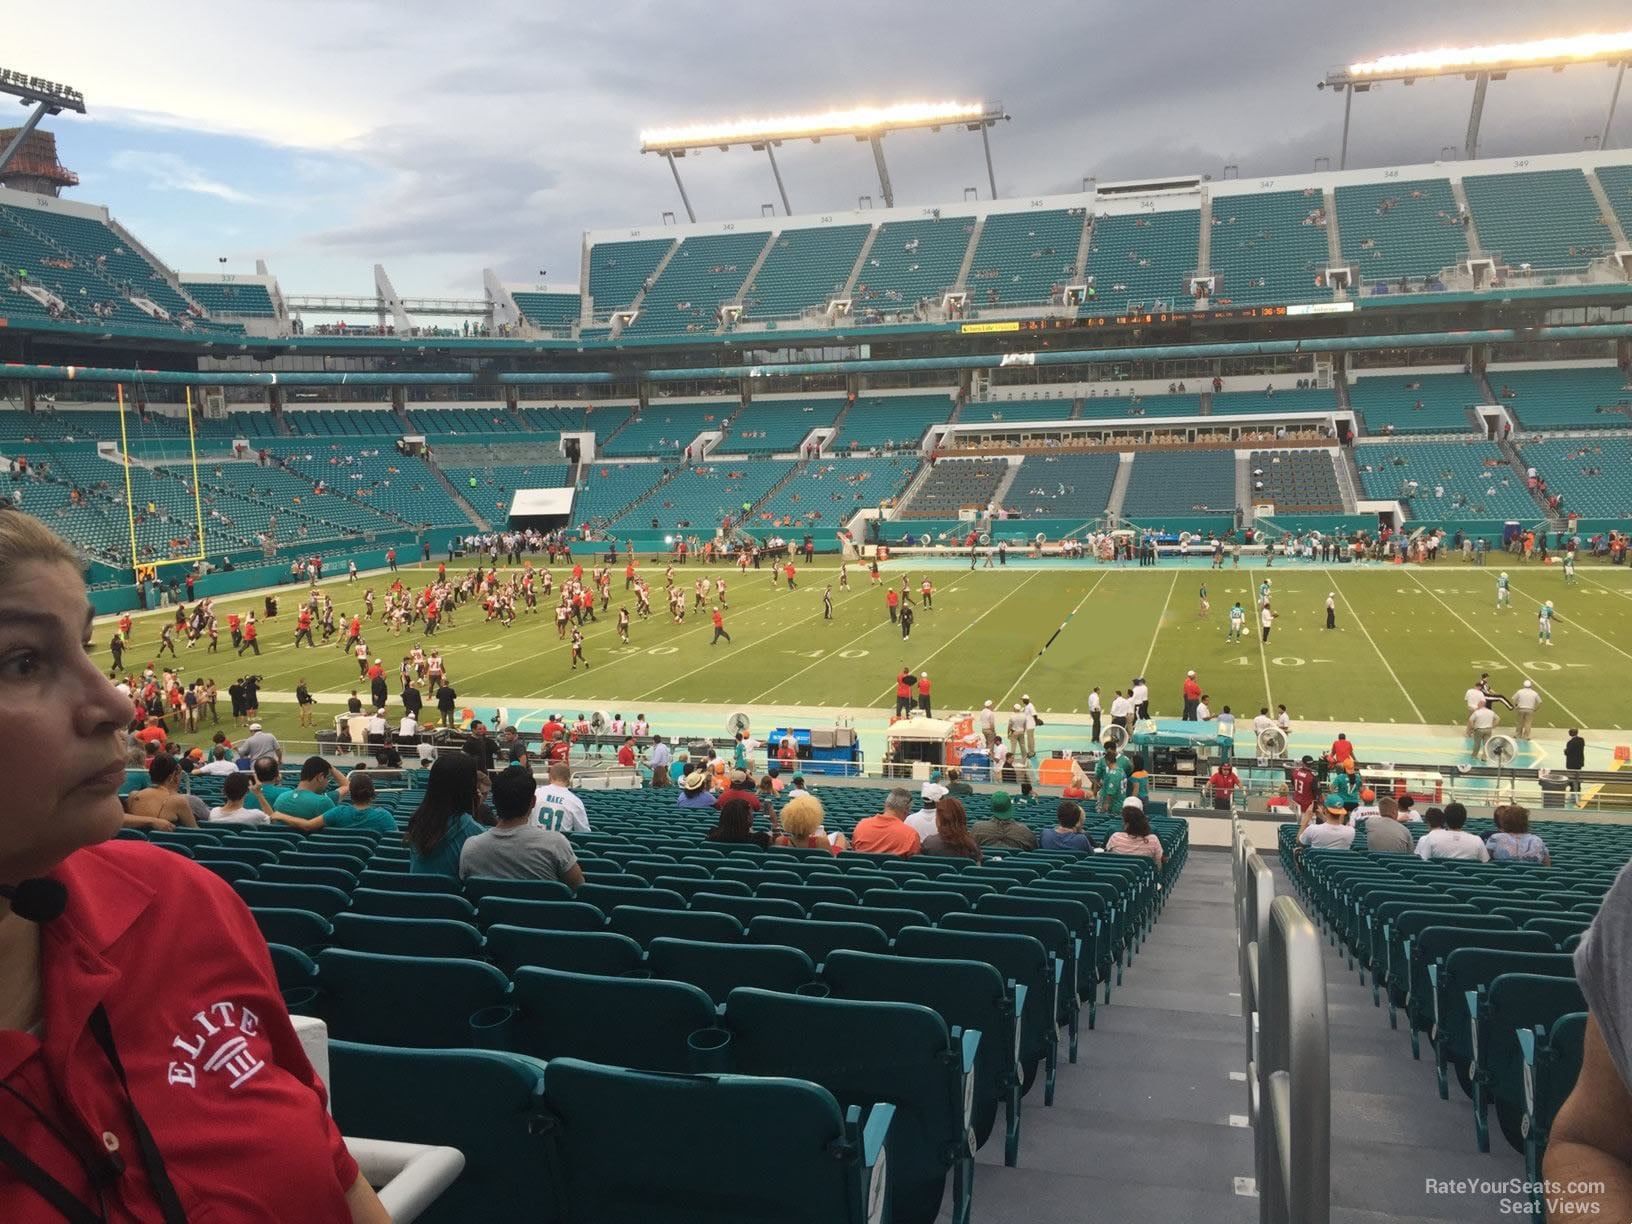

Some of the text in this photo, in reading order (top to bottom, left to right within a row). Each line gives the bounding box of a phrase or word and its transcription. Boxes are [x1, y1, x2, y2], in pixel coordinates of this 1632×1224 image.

[1512, 160, 1529, 168] 349
[1384, 170, 1399, 178] 348
[1294, 778, 1304, 794] 13
[538, 806, 565, 832] 91
[168, 1001, 259, 1089] ELITE
